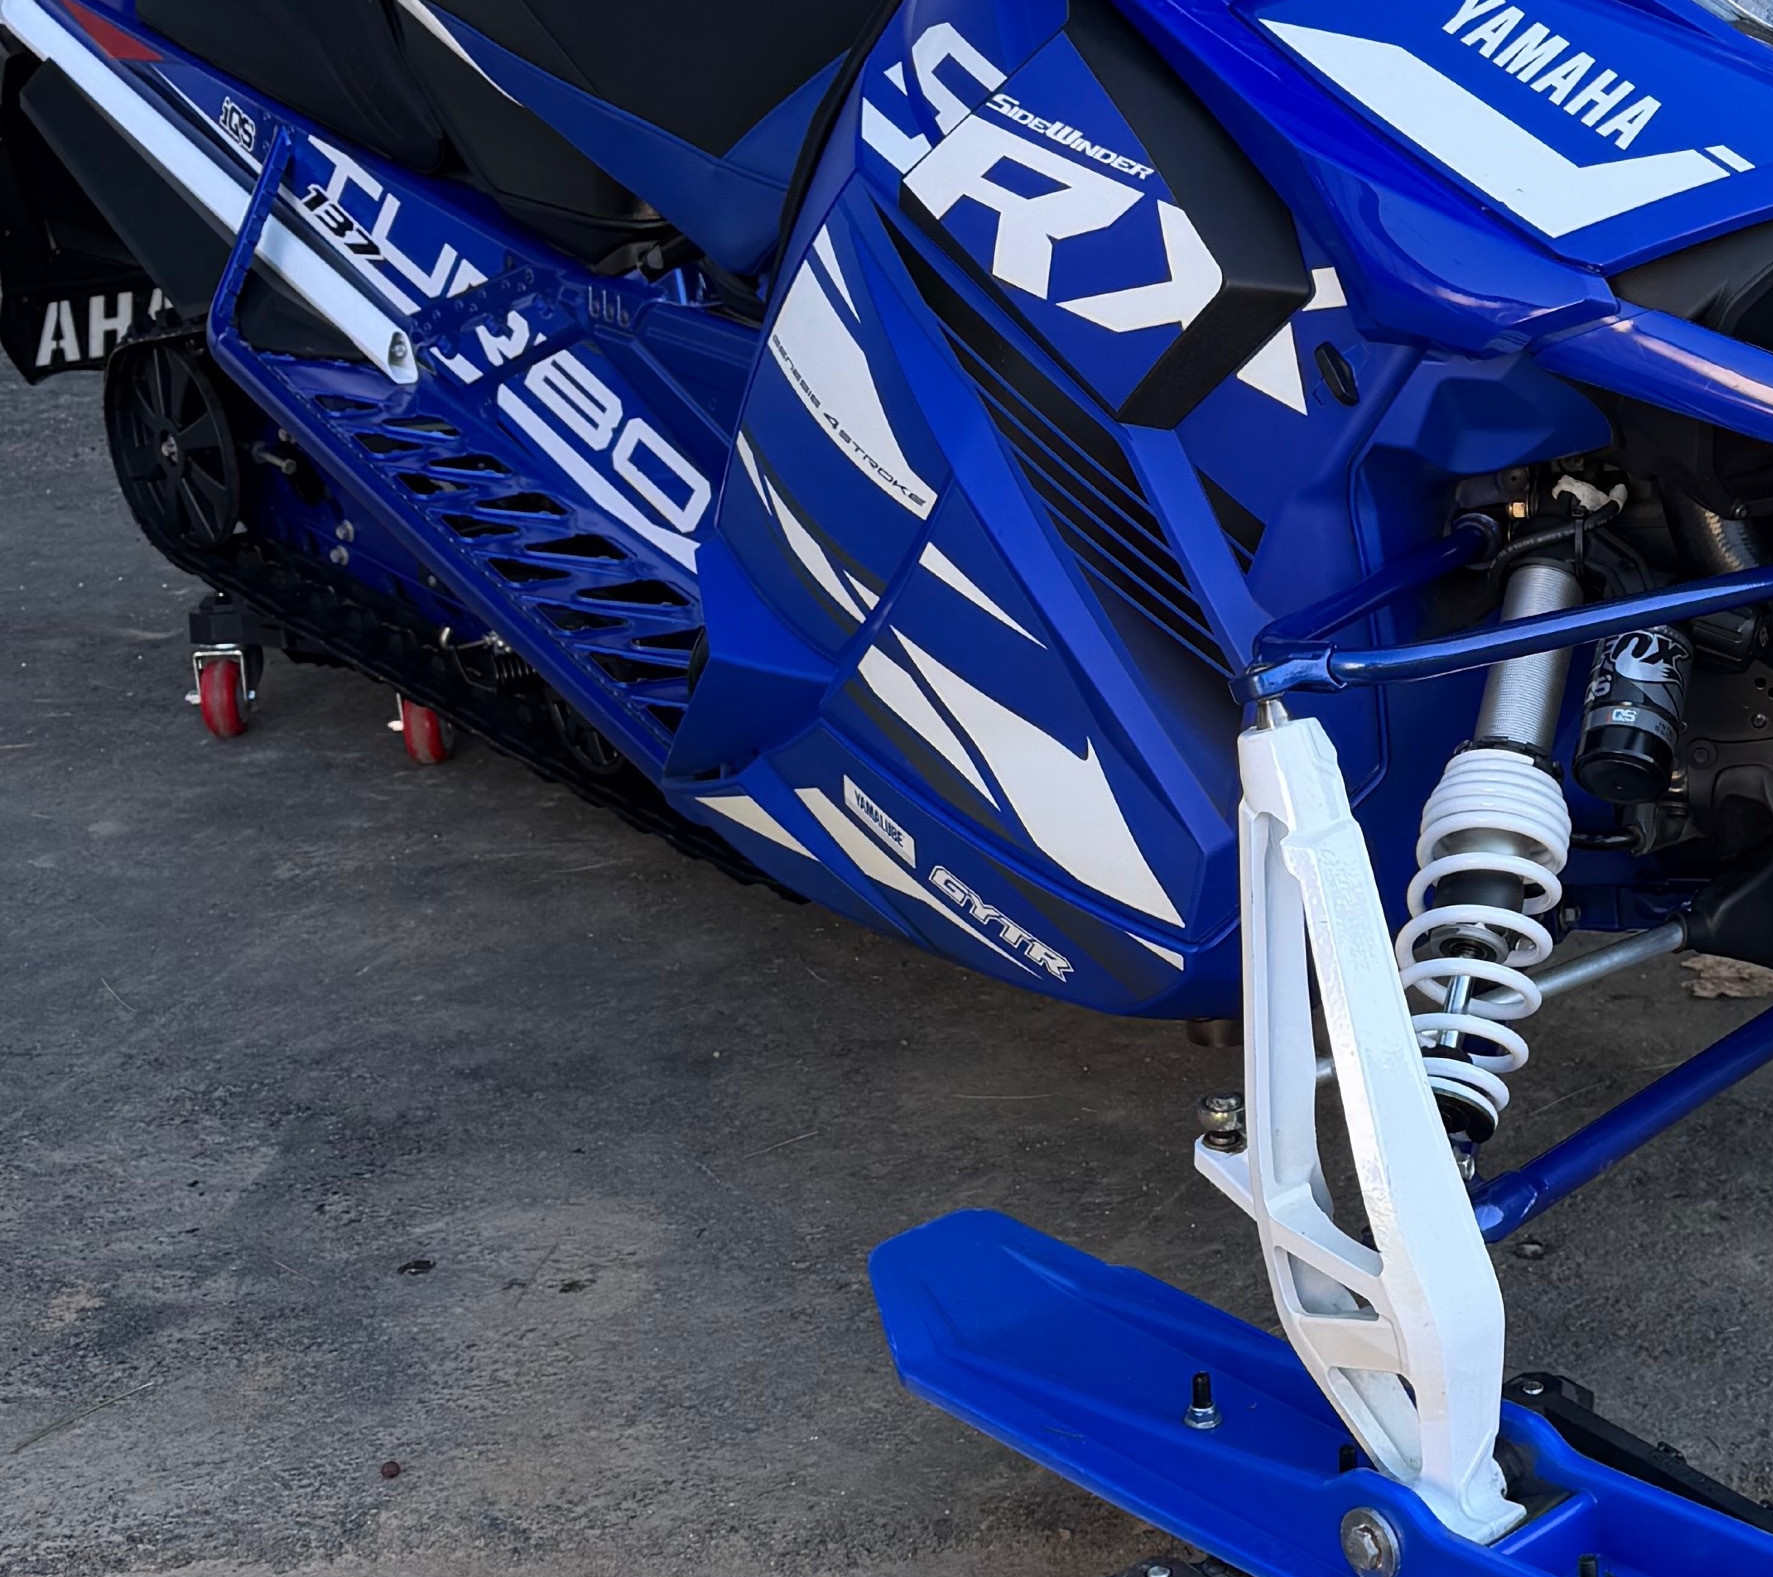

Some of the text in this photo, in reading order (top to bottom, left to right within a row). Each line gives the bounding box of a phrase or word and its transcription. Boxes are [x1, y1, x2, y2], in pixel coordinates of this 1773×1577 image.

[219, 96, 255, 152] iQS
[300, 183, 386, 262] 137
[862, 22, 1347, 416] SRX
[854, 789, 905, 848] YAMALUBE
[928, 865, 1075, 983] GYTR
